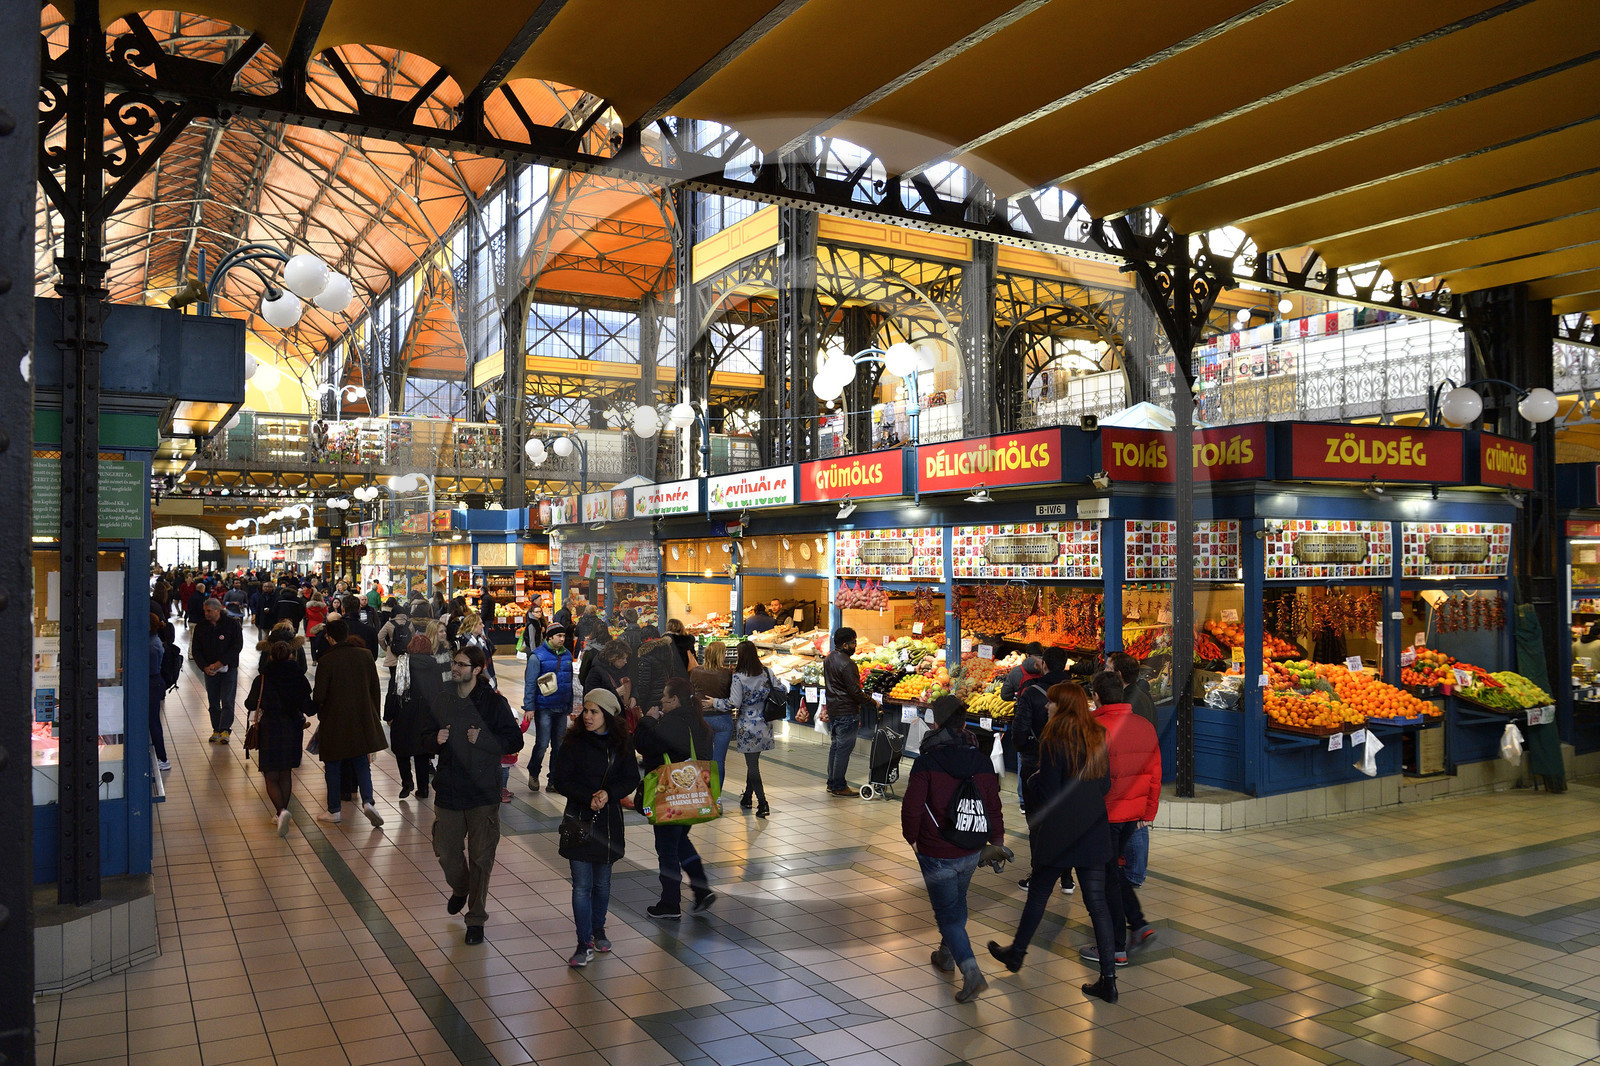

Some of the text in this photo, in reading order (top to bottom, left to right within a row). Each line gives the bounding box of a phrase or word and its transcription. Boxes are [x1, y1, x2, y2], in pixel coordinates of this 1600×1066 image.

[926, 440, 1050, 478] DÉLIGYÜMÖLCS
[1112, 439, 1168, 468] TOJÁS
[1193, 434, 1254, 467] TOJÁS
[1325, 433, 1427, 467] ZÖLDSÉG
[1486, 443, 1527, 476] GYÜMÖLCS
[816, 461, 883, 489] GYÜMÖLCS
[955, 813, 974, 831] NEW
